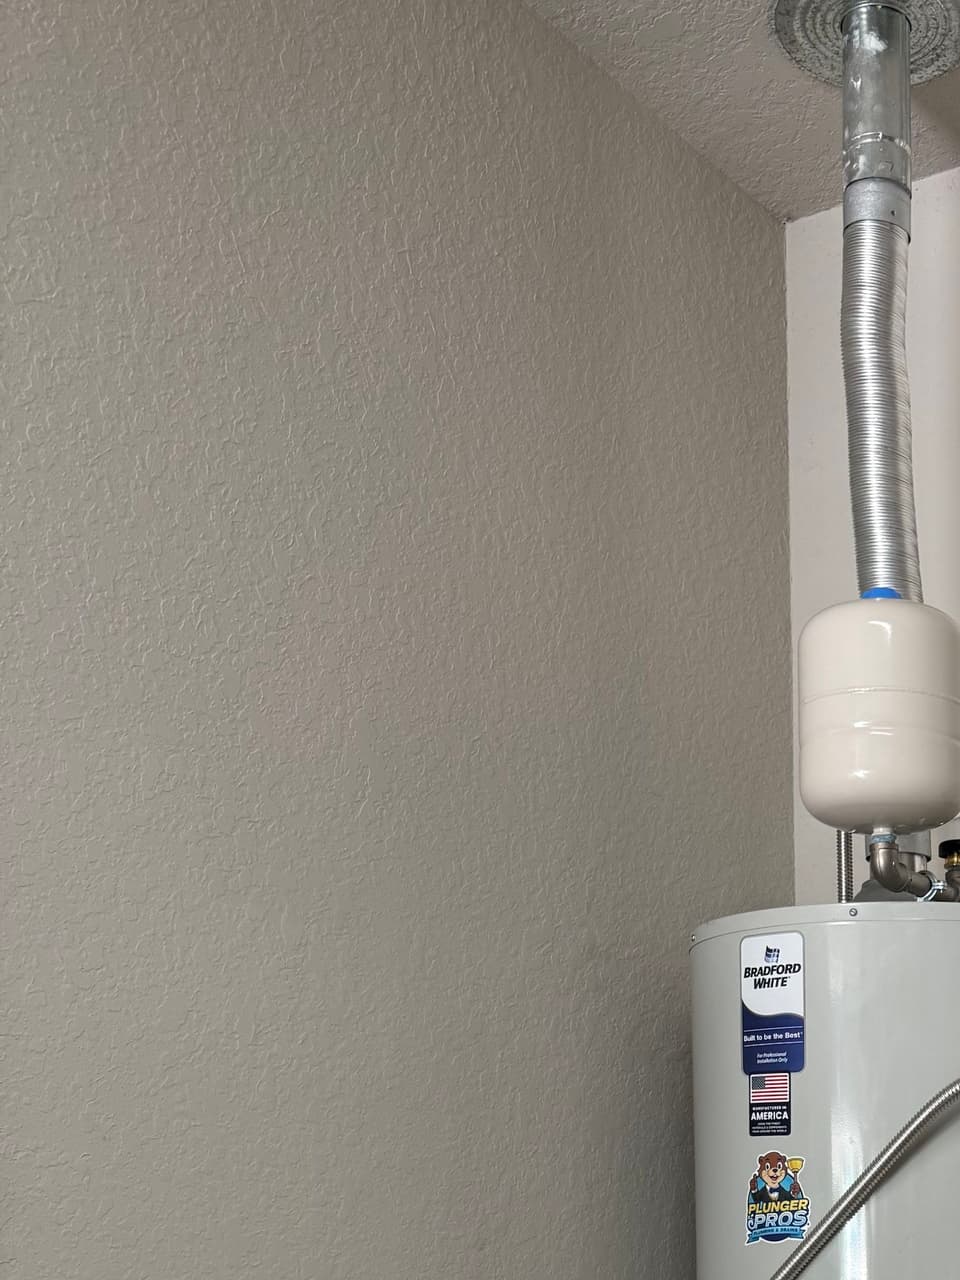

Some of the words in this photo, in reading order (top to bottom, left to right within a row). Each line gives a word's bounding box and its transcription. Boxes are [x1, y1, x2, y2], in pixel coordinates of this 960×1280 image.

[744, 963, 801, 978] BRADFORD
[753, 976, 788, 990] WHITE
[773, 1032, 783, 1040] the
[784, 1031, 801, 1039] Best
[751, 1111, 789, 1120] AMERICA
[749, 1199, 808, 1214] PLUNGER
[748, 1210, 807, 1229] PROS
